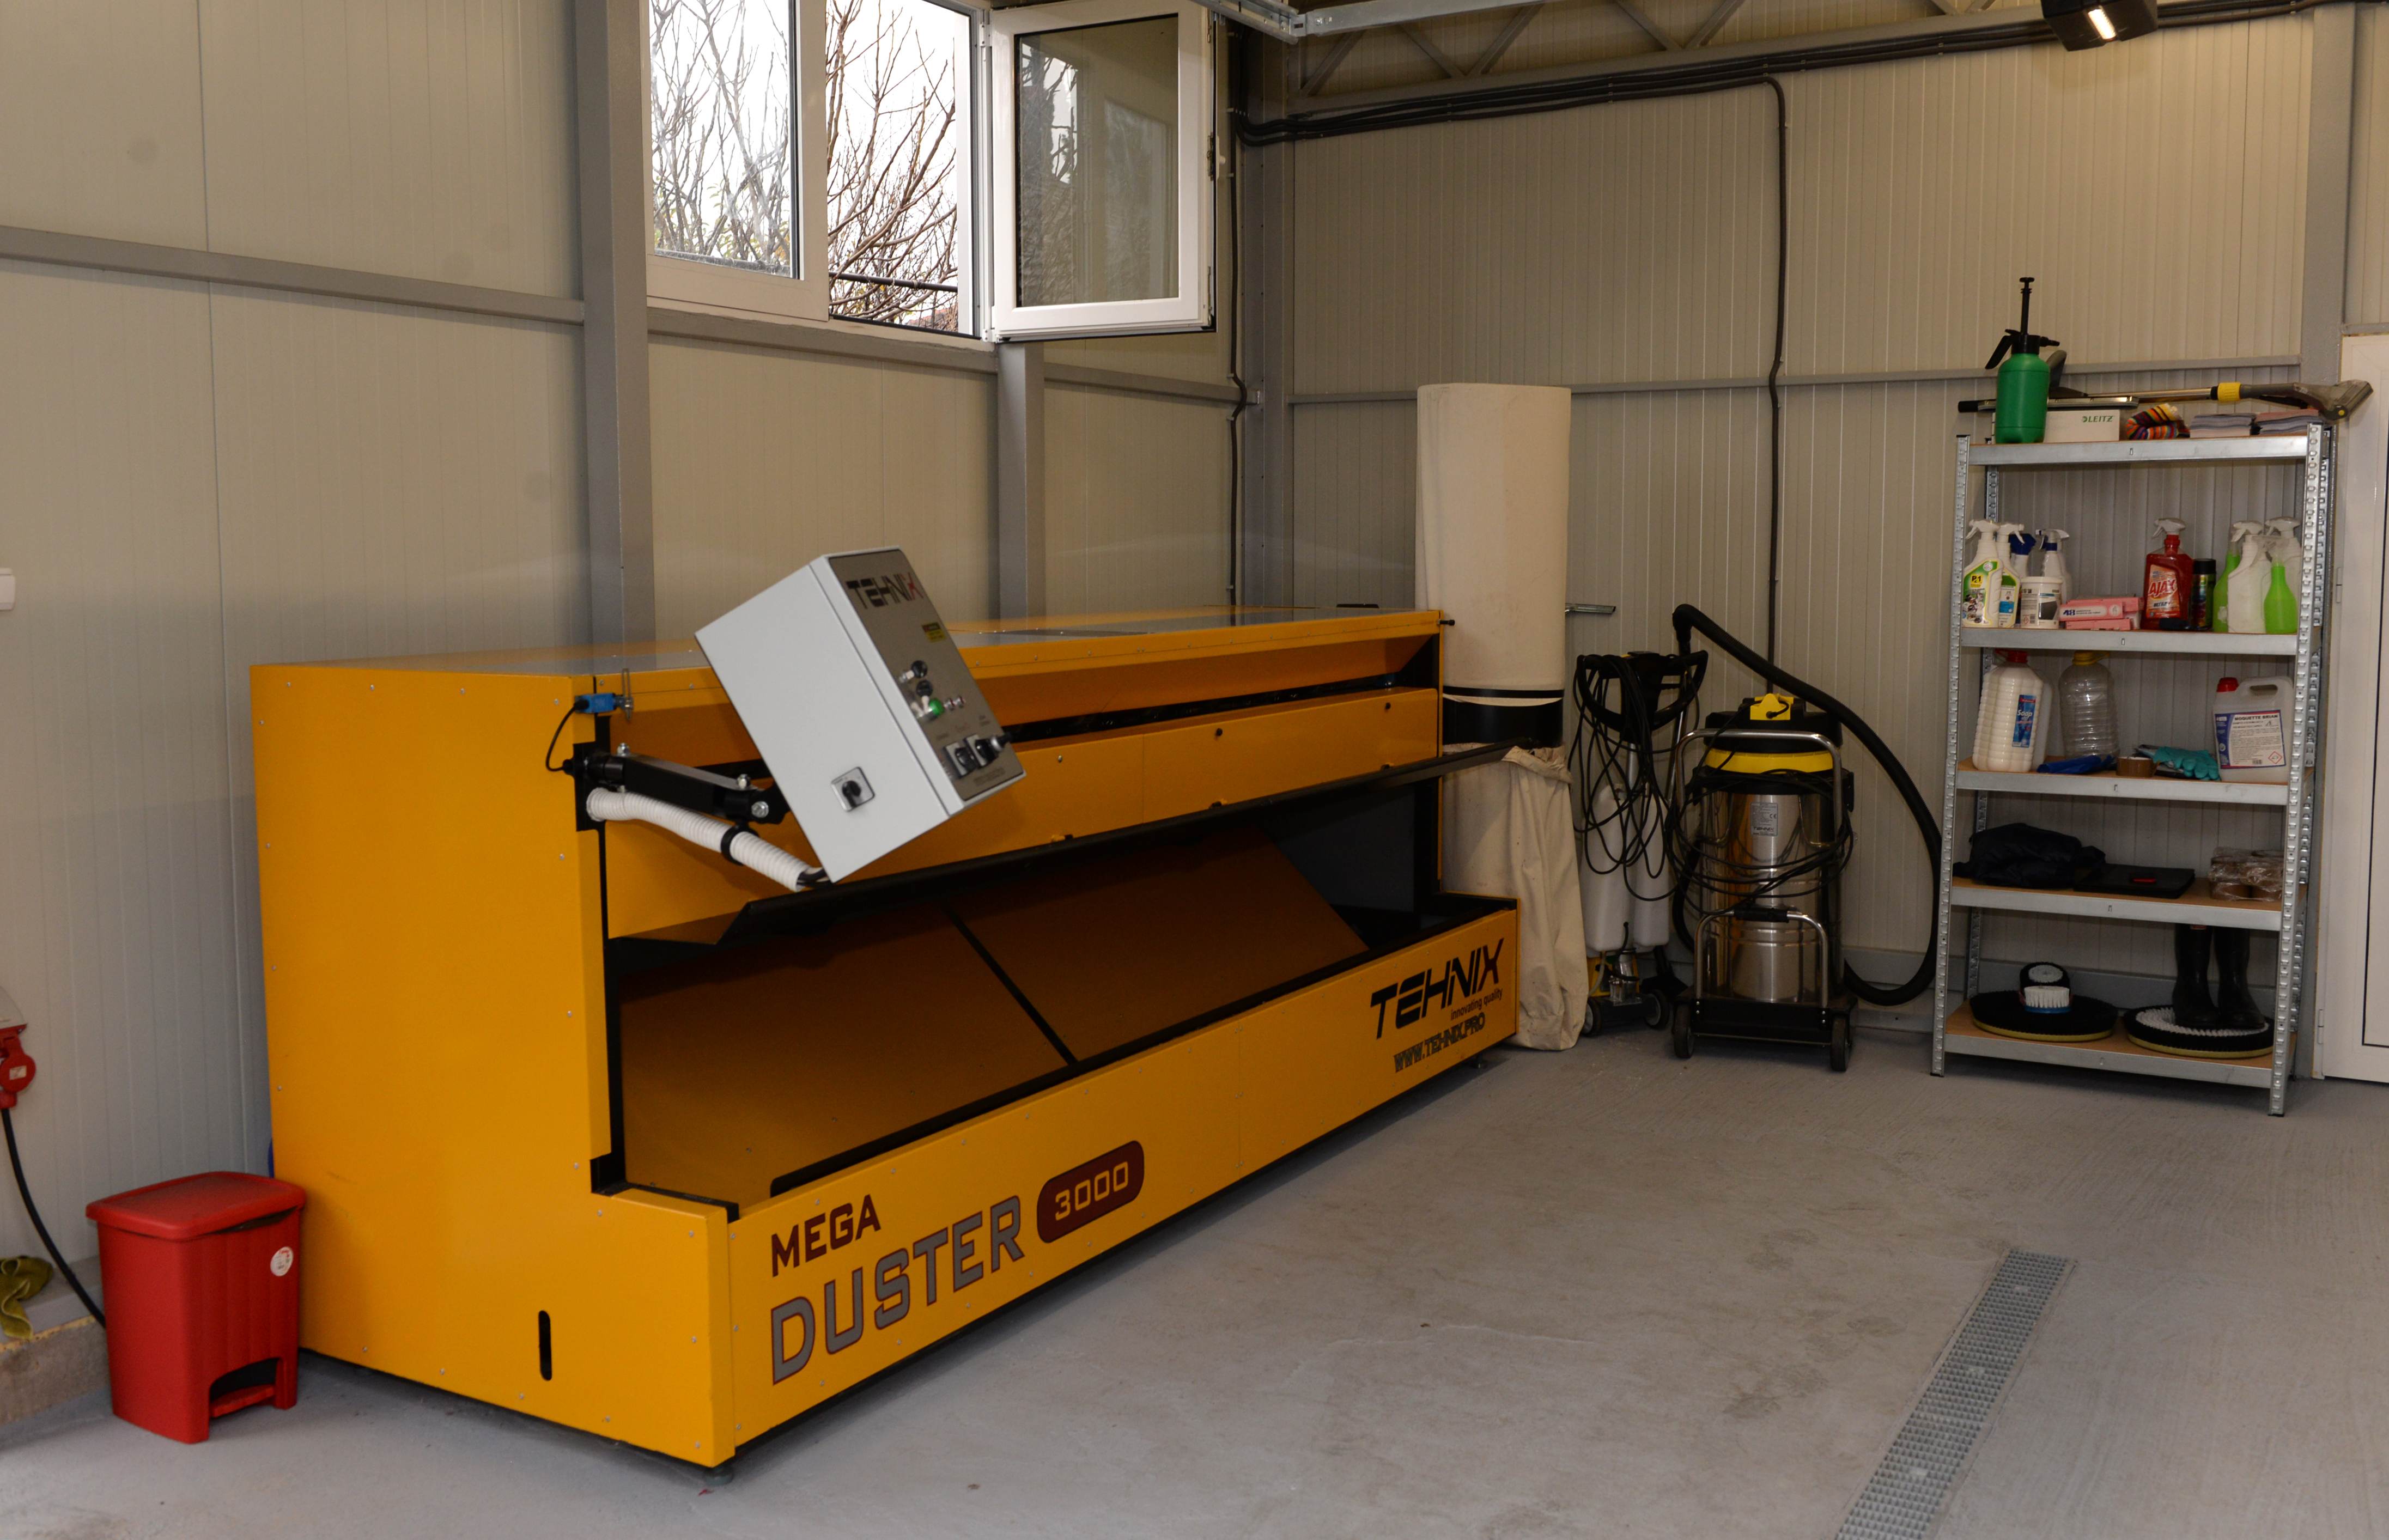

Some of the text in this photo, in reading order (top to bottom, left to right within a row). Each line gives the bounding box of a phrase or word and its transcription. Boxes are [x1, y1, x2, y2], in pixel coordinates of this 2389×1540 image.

[846, 572, 925, 610] TEHNIX
[2148, 579, 2177, 596] AJAX
[2017, 709, 2033, 718] Soap
[1370, 937, 1504, 1039] TEHNIX
[1451, 987, 1503, 1021] innovating quality
[1054, 1160, 1129, 1222] 3000
[771, 1194, 882, 1277] MEGA
[770, 1195, 1025, 1385] DUSTER
